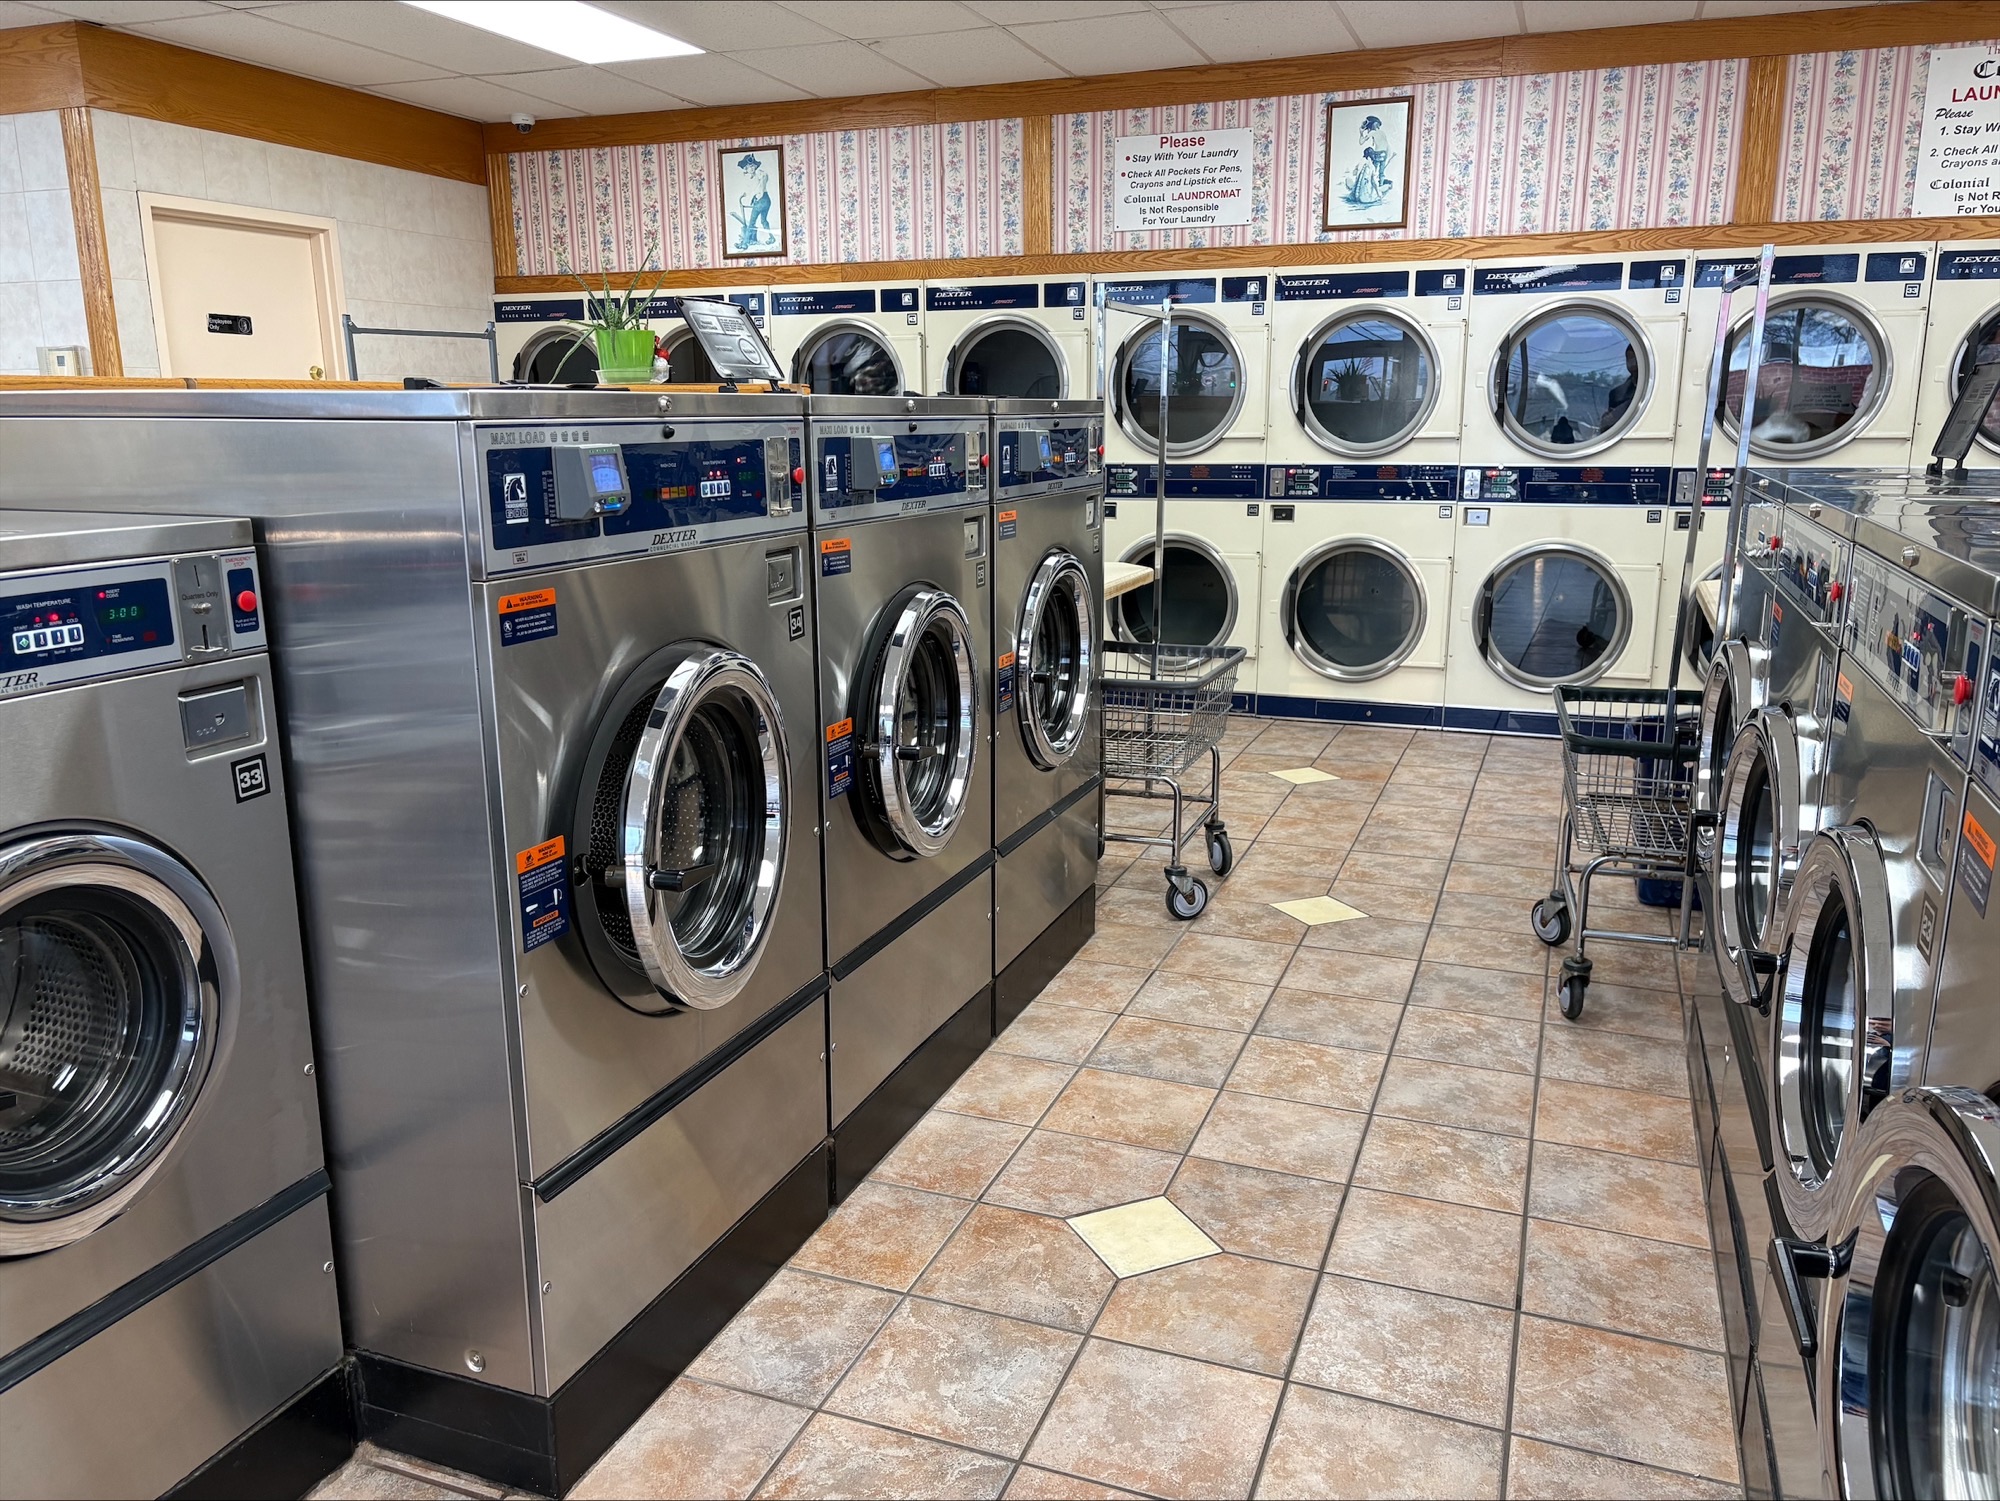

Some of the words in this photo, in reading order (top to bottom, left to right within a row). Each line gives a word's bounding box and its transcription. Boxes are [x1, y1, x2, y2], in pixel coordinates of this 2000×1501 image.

[1934, 108, 1974, 120] Please
[1940, 126, 1949, 136] 1.
[1954, 124, 1982, 136] Stay
[1160, 136, 1206, 148] Please
[1132, 154, 1152, 164] Stay
[1154, 152, 1174, 162] With
[1176, 152, 1198, 160] Your
[1200, 148, 1239, 159] Laundry
[1930, 148, 1938, 157] 2.
[1944, 146, 1978, 156] Check
[1982, 144, 1998, 154] All
[1941, 158, 1988, 170] Crayons
[1127, 170, 1152, 178] Check
[1154, 168, 1166, 176] All
[1168, 167, 1200, 176] Pockets
[1203, 166, 1217, 174] For
[1220, 164, 1242, 174] Pens,
[1130, 180, 1164, 190] Crayons
[1166, 179, 1181, 187] and
[1184, 177, 1216, 186] Lipstick
[1930, 177, 1990, 190] Colonial
[1124, 193, 1165, 204] Colonial
[1172, 189, 1241, 201] LAUNDROMAT
[1954, 193, 1964, 202] Is
[1968, 192, 1988, 202] Not
[1150, 206, 1164, 214] Not
[1166, 203, 1219, 215] Responsible
[1958, 205, 1977, 214] For
[1142, 217, 1156, 225] For
[1158, 216, 1178, 224] Your
[1180, 214, 1216, 224] Laundry
[820, 426, 832, 434] MAXI
[834, 425, 848, 434] LOAD
[490, 432, 516, 444] MAXI
[519, 431, 546, 444] LOAD
[902, 500, 926, 511] DEXTER
[652, 530, 696, 546] DEXTER
[16, 602, 32, 610] WASH
[33, 598, 72, 608] TEMPERATURE
[519, 594, 543, 602] WARNING
[13, 682, 44, 692] WASHER
[240, 768, 262, 788] 33
[538, 842, 556, 854] WARNING
